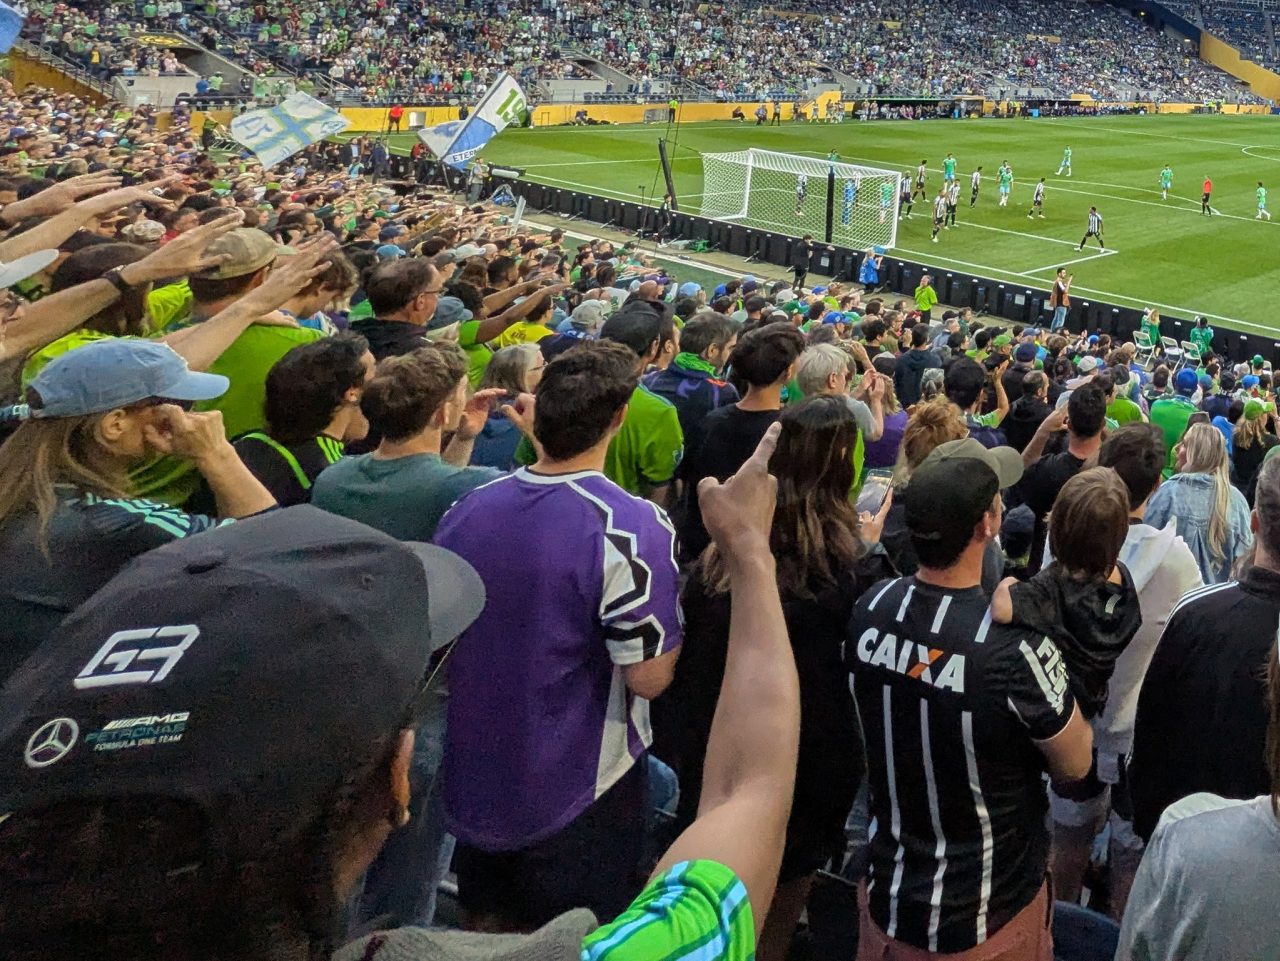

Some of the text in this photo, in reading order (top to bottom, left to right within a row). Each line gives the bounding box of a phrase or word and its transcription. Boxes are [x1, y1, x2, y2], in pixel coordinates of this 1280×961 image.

[856, 627, 966, 693] CAIXA
[131, 712, 190, 727] AMG
[159, 734, 183, 744] TEAM
